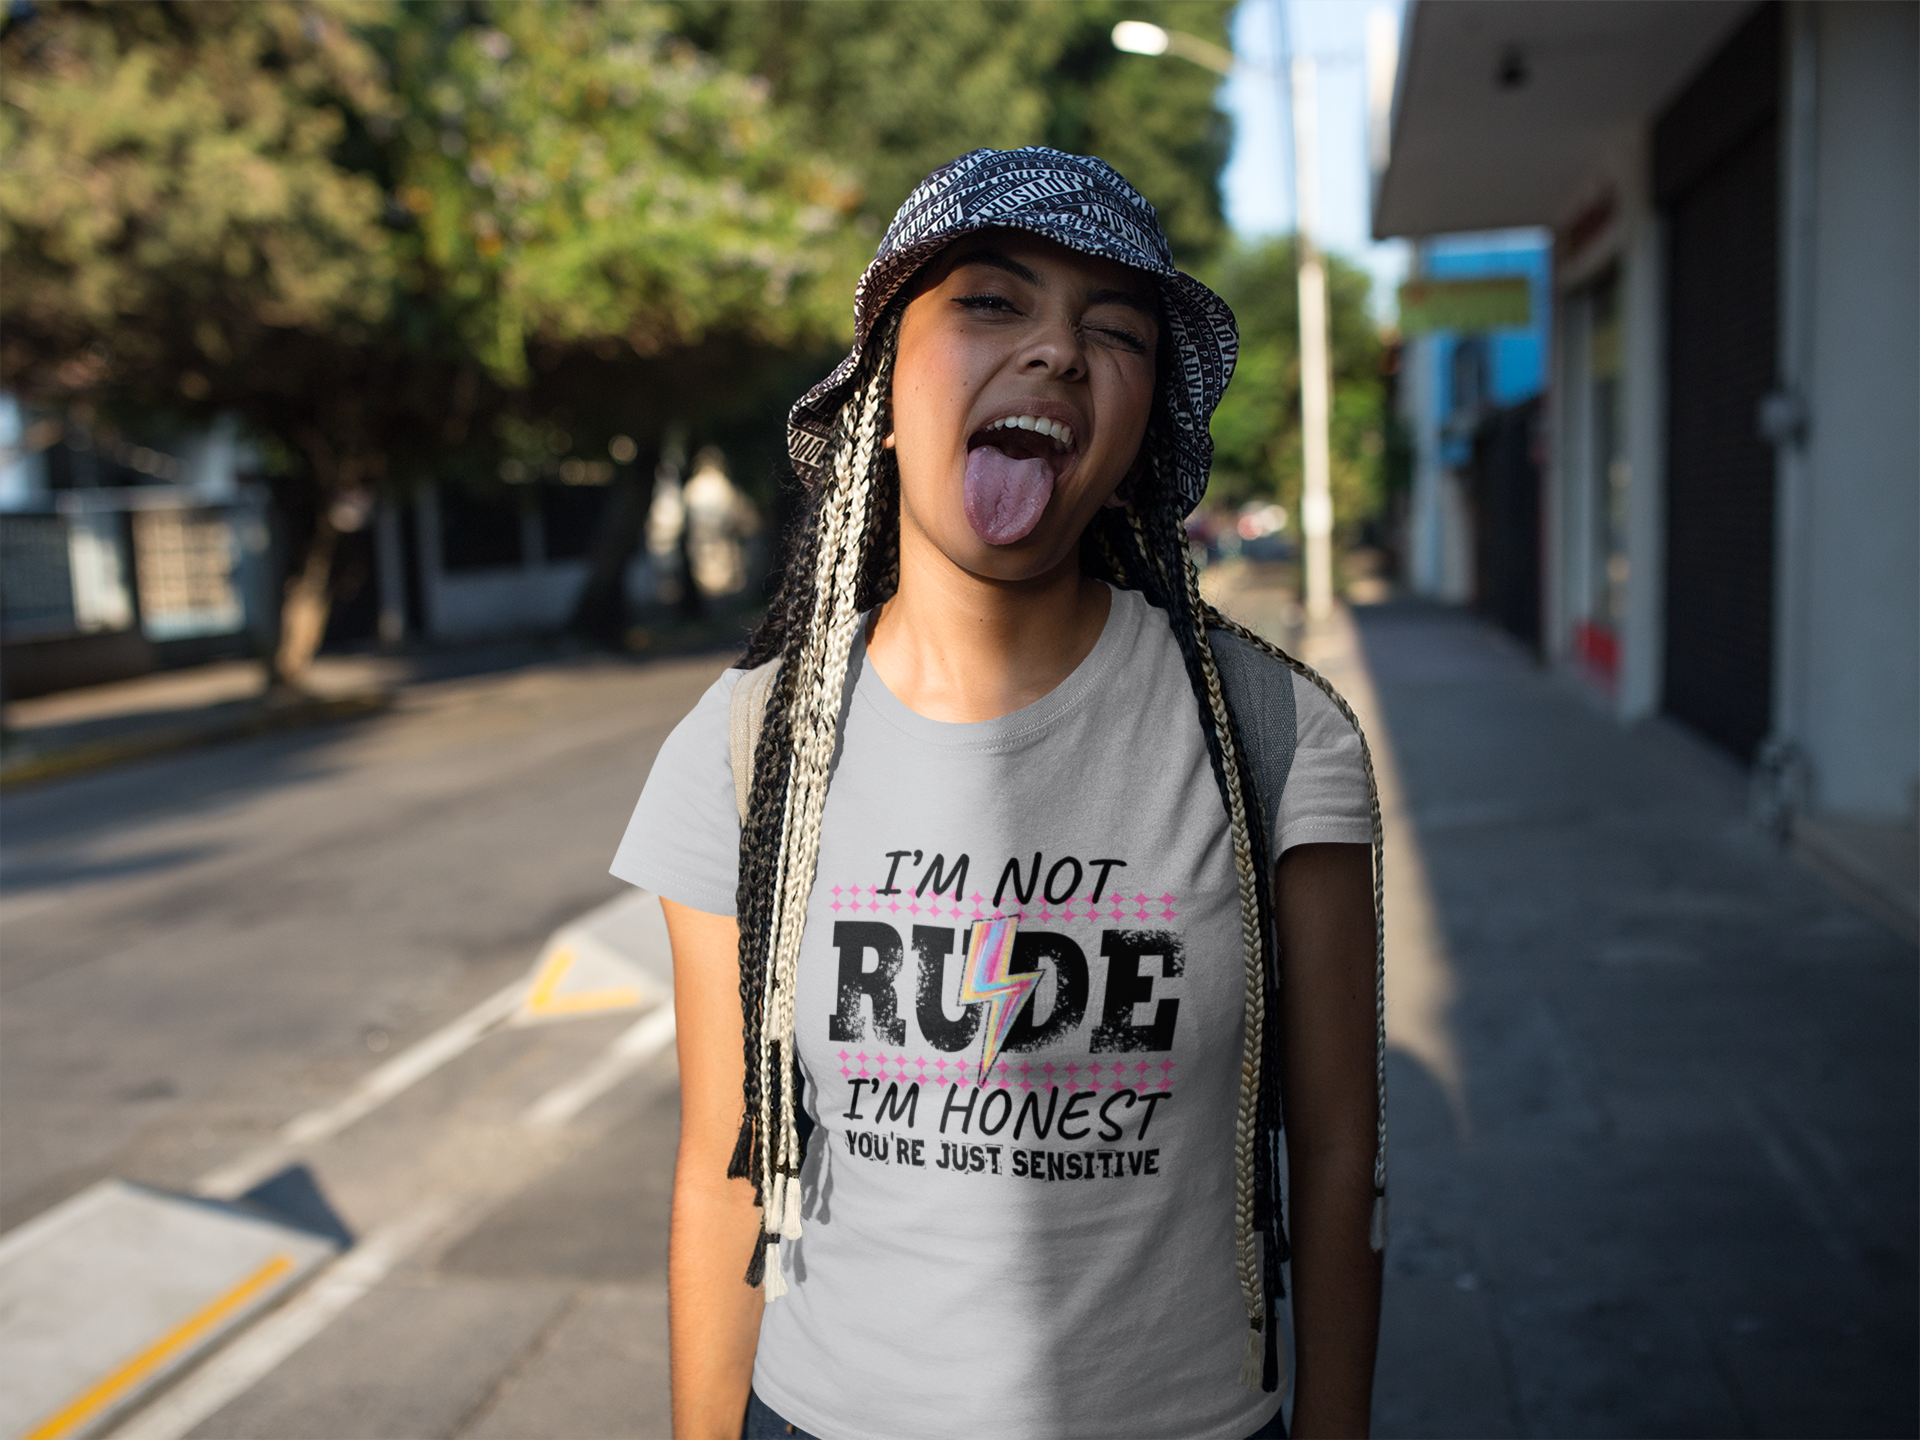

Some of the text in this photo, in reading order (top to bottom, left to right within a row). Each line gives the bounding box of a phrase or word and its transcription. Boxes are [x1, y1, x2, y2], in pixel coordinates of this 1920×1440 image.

[984, 161, 1084, 179] PARENTAL
[1199, 348, 1214, 412] PAREN
[1210, 315, 1239, 381] ADVIS
[1179, 348, 1204, 416] ADVIS
[876, 850, 1127, 908] I'M NOT
[829, 920, 1187, 1054] RUDE
[843, 1078, 1173, 1142] I'M HONEST
[845, 1130, 1161, 1182] YOU'RE JUST SENSITIVE
